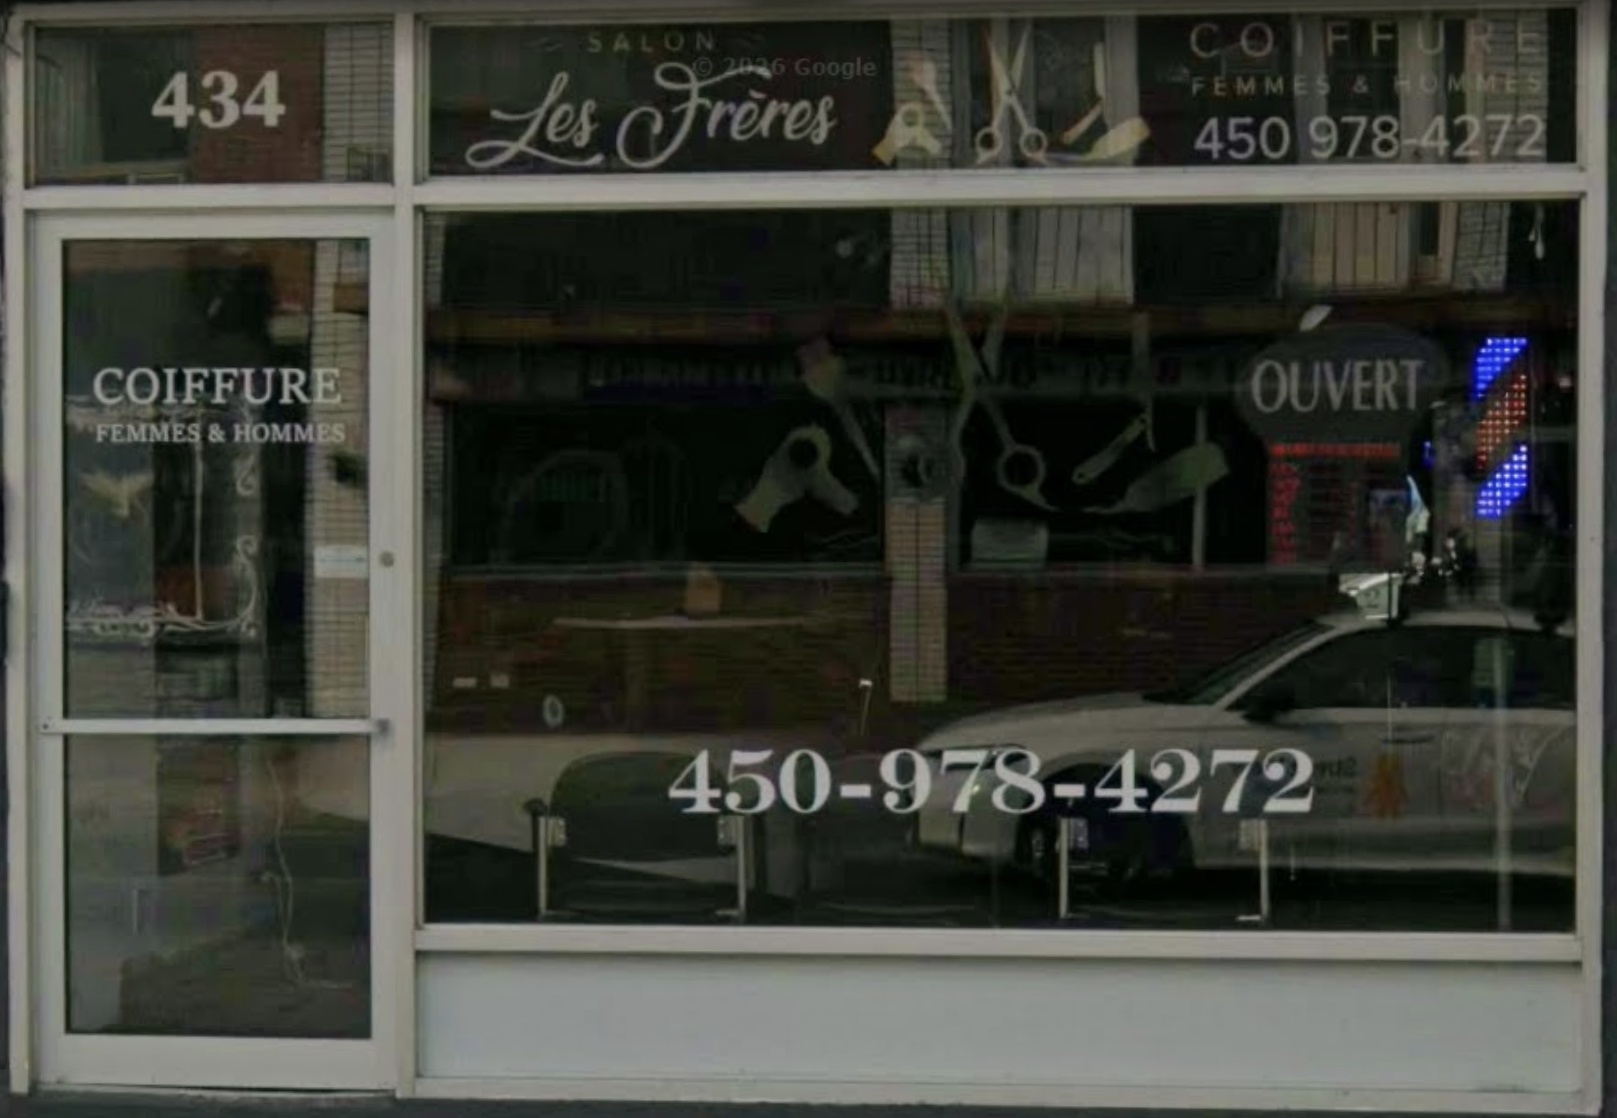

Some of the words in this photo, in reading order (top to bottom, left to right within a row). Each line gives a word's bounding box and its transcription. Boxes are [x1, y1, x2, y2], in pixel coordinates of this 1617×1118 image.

[586, 30, 719, 53] SALON
[1189, 20, 1541, 58] COIFFURE
[151, 69, 286, 129] 434
[1191, 75, 1331, 98] FEMMES
[1352, 78, 1370, 95] &
[1394, 74, 1542, 95] HOMMES
[464, 70, 605, 168] Les
[616, 61, 838, 169] Frères
[1193, 115, 1291, 160] 450
[1309, 114, 1546, 160] 978-4272
[93, 366, 342, 406] COIFFURE
[1250, 358, 1425, 415] OUVERT
[96, 422, 201, 444] FEMMES
[208, 423, 226, 443] &
[234, 422, 345, 444] HOMMES
[668, 746, 1315, 815] 450-978-4272
